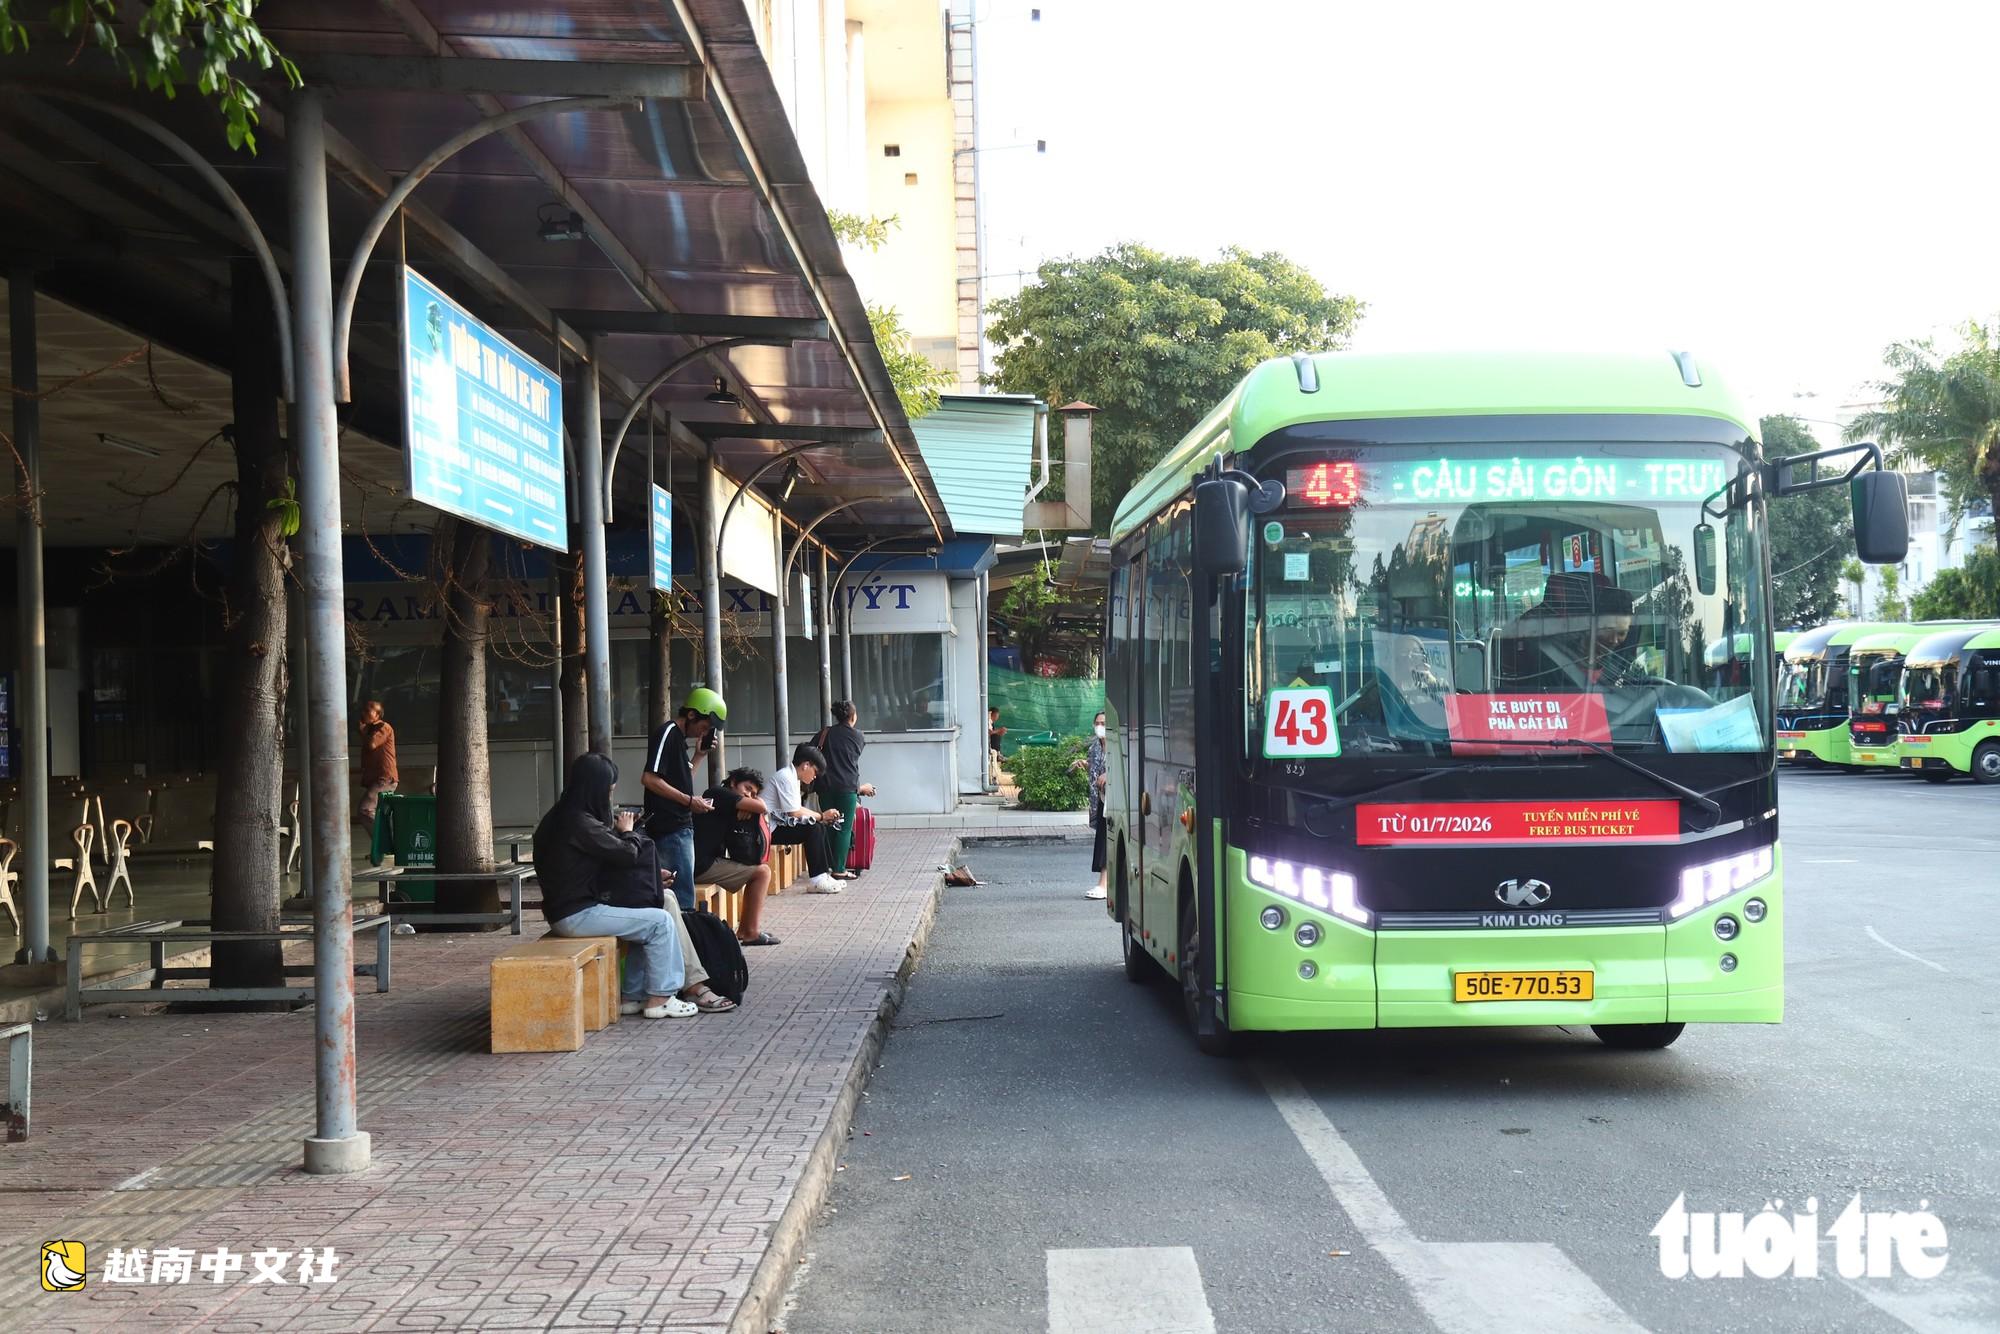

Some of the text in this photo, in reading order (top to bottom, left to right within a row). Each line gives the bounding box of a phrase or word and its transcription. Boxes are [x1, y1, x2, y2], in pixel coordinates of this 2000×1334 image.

[1306, 463, 1358, 505] 43
[1412, 458, 1477, 498] CẦU
[1486, 457, 1534, 497] SÀI
[1542, 456, 1617, 497] GÒN
[1489, 699, 1561, 714] XE BUÝT ĐI
[1275, 699, 1327, 745] 43
[1488, 714, 1569, 730] PHÀ CÁT LÁI
[1378, 813, 1493, 833] TỪ 01/7/2026
[1522, 807, 1640, 822] TUYẾN MIỄN PHÍ VÉ
[1529, 825, 1635, 836] FREE BUS TICKET
[1482, 914, 1563, 927] KIM LONG
[1467, 977, 1581, 995] 50E-770.53
